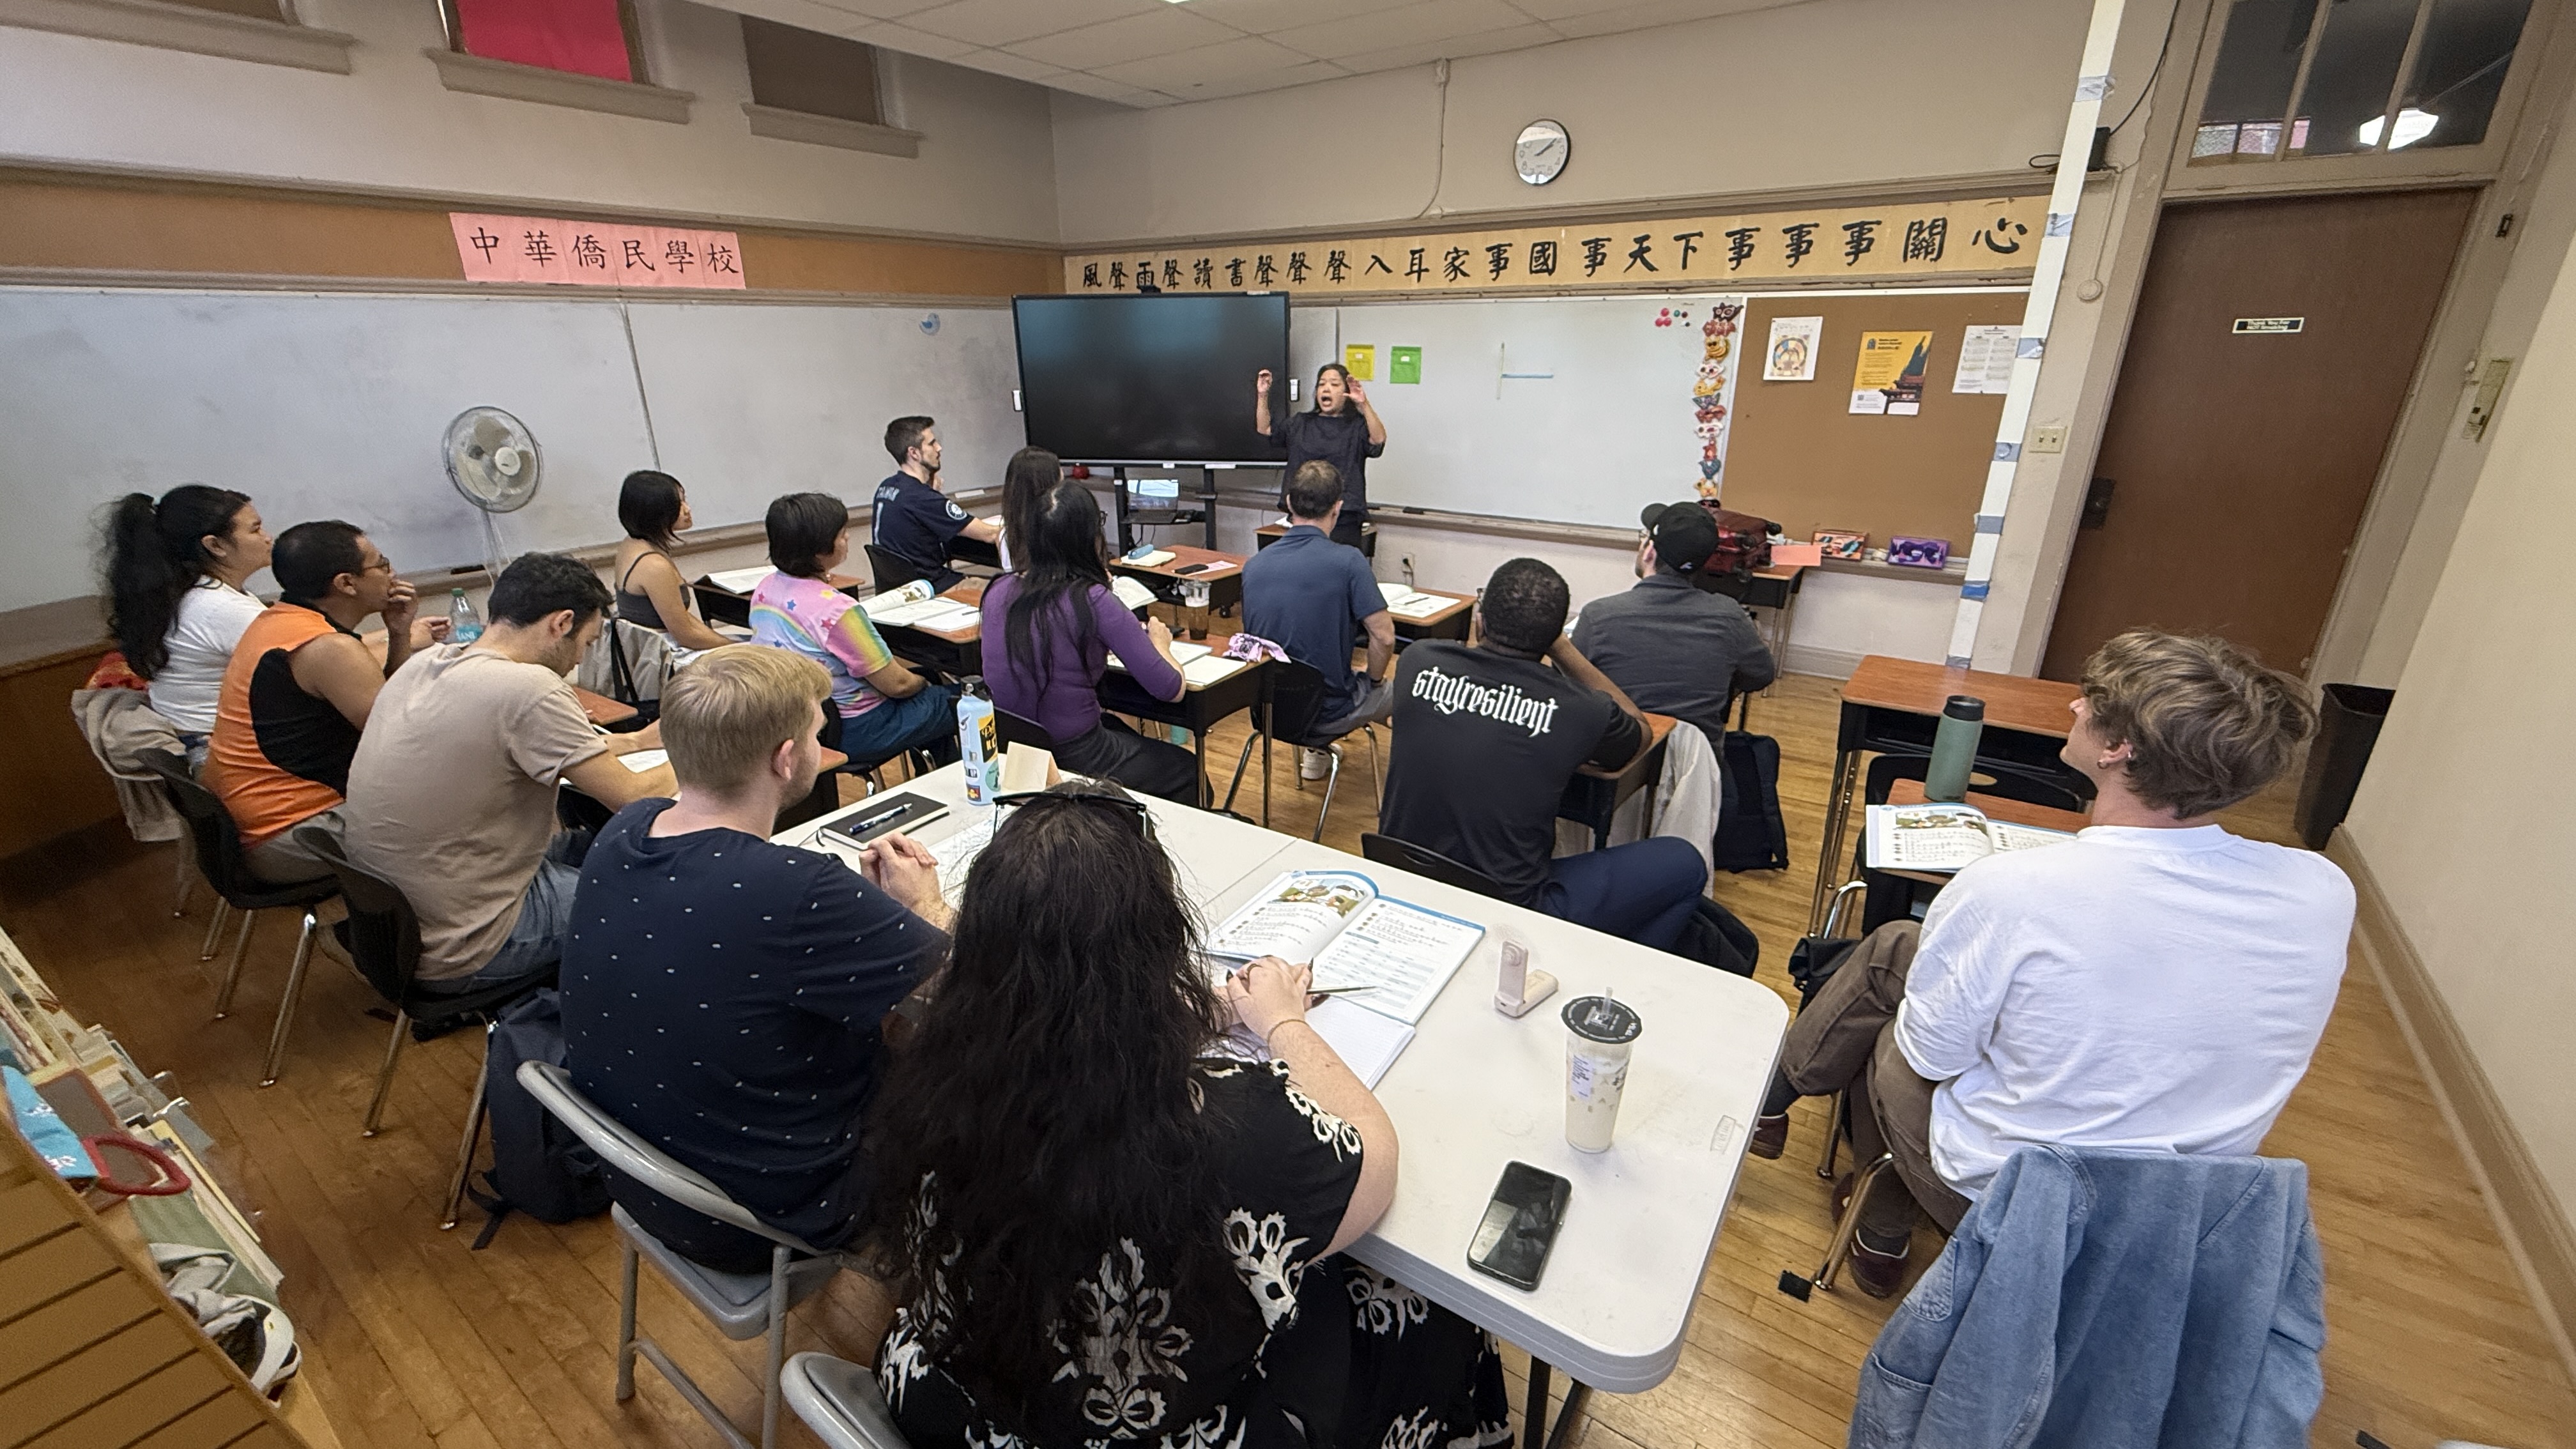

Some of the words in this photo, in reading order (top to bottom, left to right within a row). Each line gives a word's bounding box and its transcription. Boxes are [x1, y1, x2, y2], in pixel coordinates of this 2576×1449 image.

[470, 226, 739, 275] 中華僑民學校
[1412, 666, 1560, 738] stayresilient
